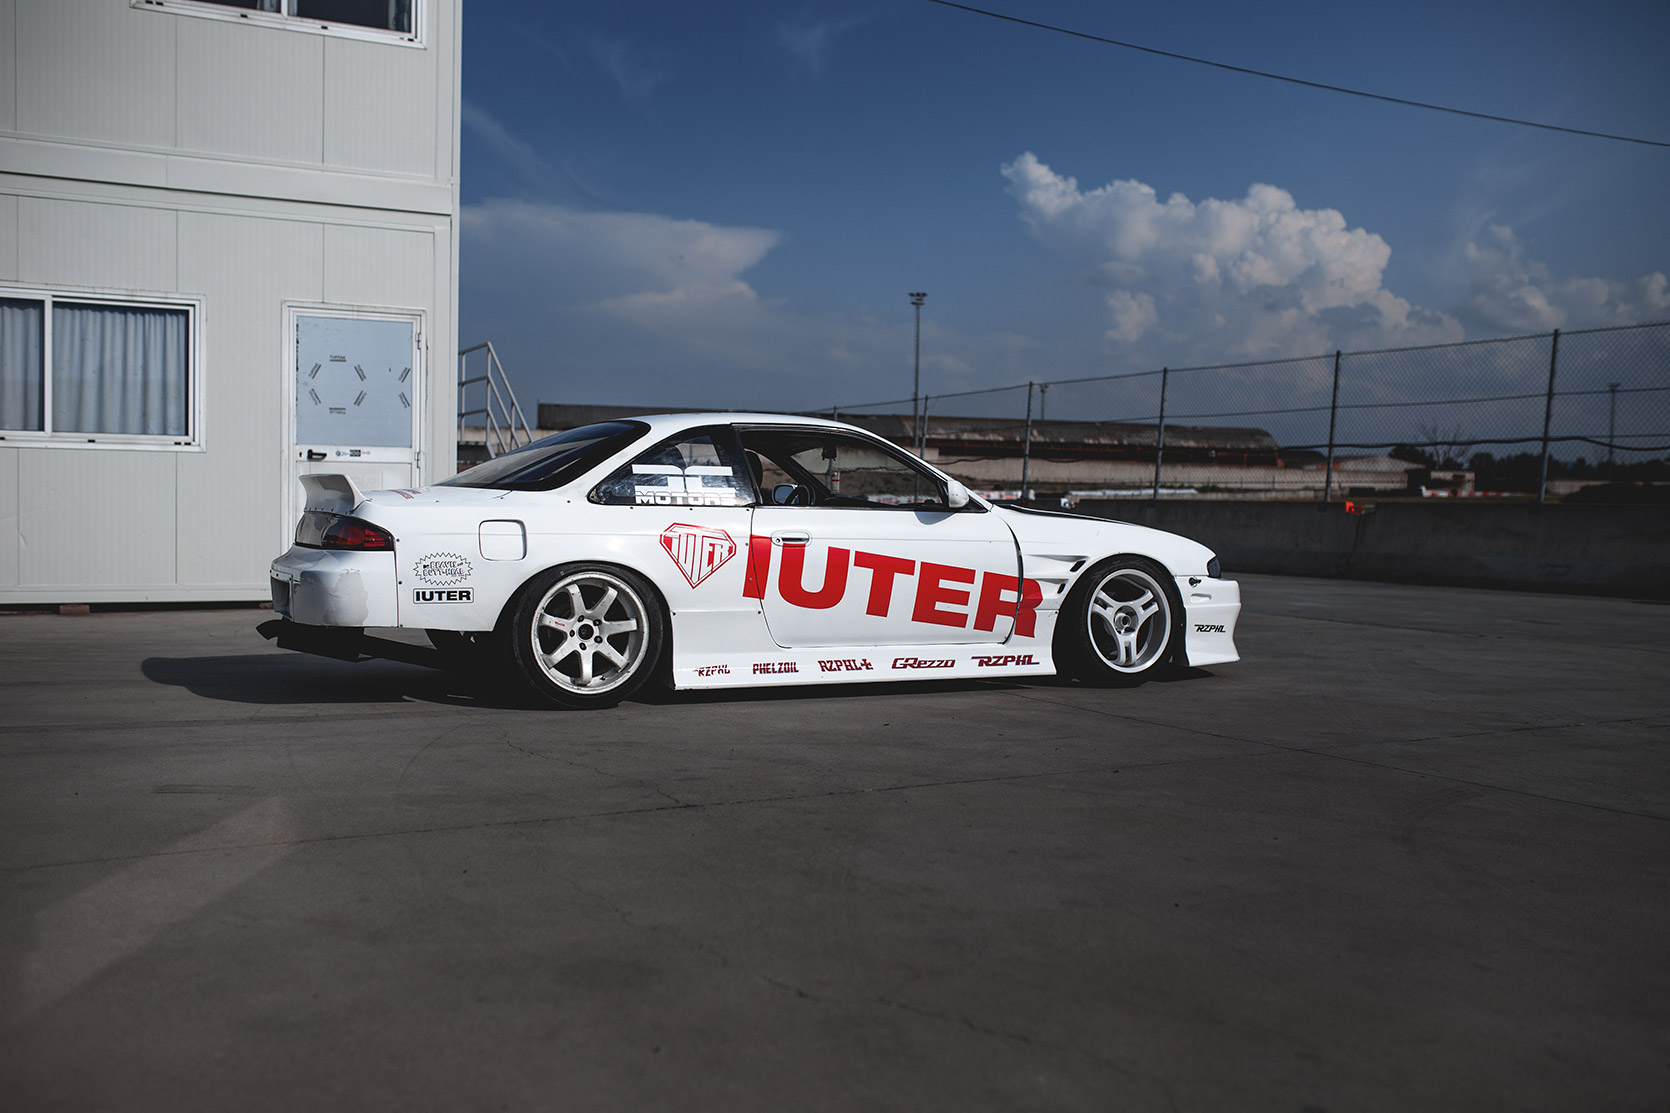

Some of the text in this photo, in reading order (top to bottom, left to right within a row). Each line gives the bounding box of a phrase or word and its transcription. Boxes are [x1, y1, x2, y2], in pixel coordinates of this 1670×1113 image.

[743, 534, 1043, 638] IUTER
[416, 590, 471, 601] IUTER
[1194, 624, 1226, 633] RZPHL
[971, 655, 1040, 666] RZPHL
